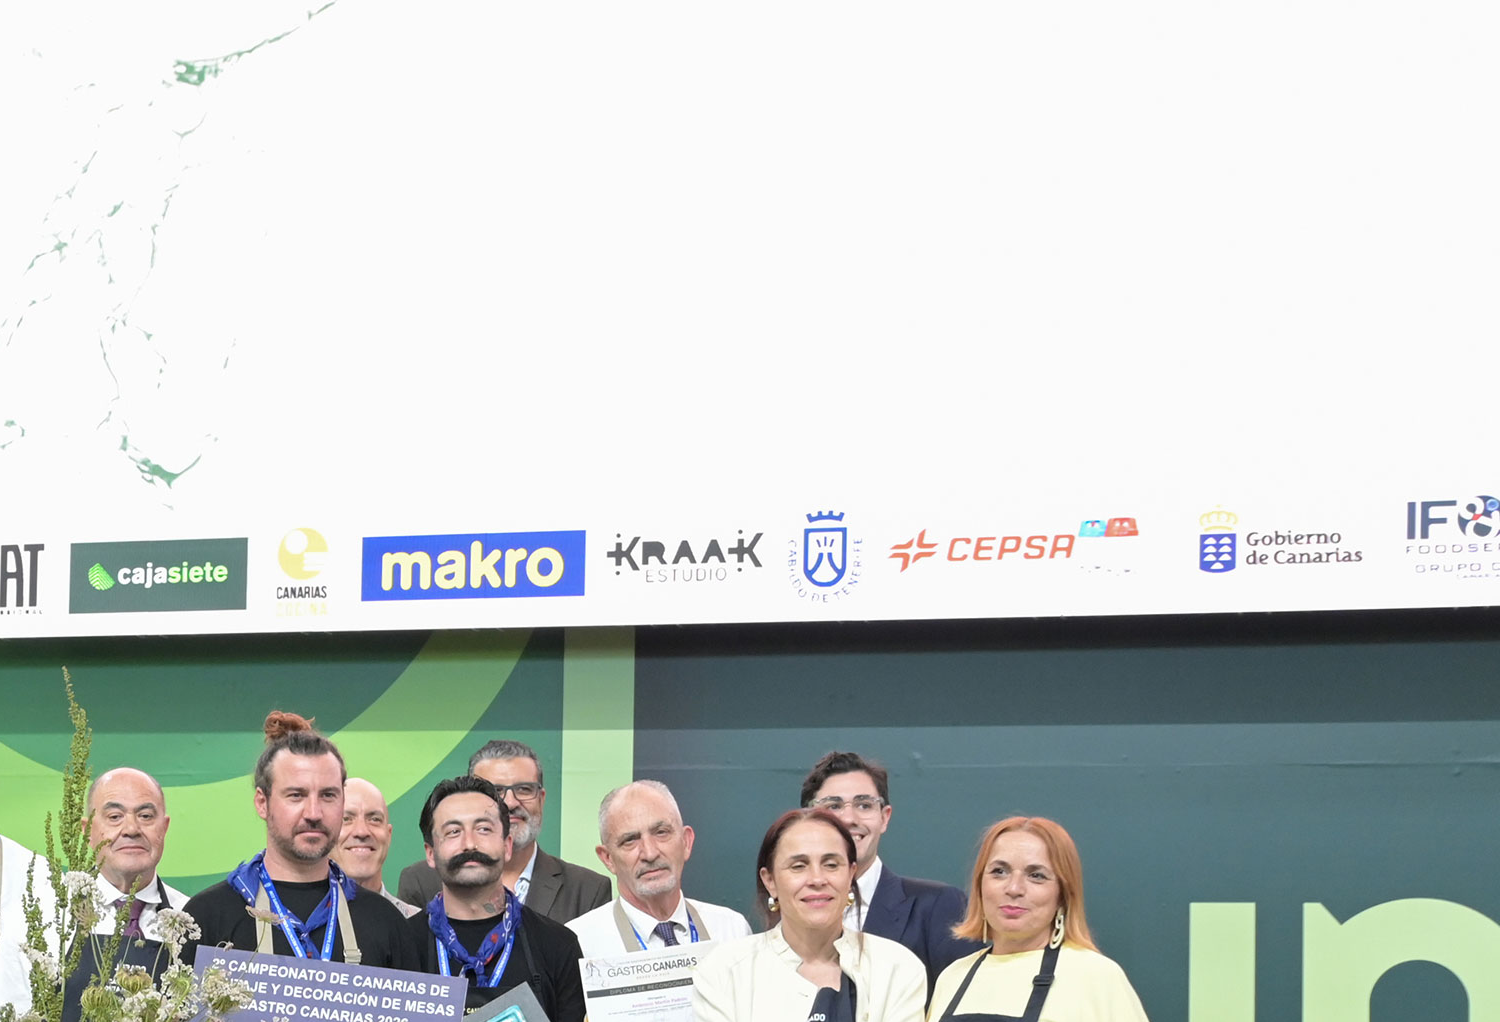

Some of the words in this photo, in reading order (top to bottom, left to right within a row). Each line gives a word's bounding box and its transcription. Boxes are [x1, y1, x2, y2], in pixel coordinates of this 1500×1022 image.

[946, 534, 1075, 561] CEPSA
[1246, 529, 1342, 547] Gobierno
[1246, 549, 1269, 566] de
[1272, 546, 1363, 565] Canarias
[1406, 543, 1500, 554] FOODSE
[117, 561, 228, 589] cajasiete
[381, 540, 565, 591] makro
[644, 566, 728, 584] ESTUDIO
[1415, 563, 1481, 573] GRUPO
[277, 585, 327, 599] CANARIAS
[229, 960, 326, 982] CAMPEONATO
[330, 973, 349, 986] DE
[353, 975, 426, 995] CANARIAS
[430, 984, 450, 998] DE
[610, 987, 636, 995] DIPLOMA
[647, 979, 694, 990] RECONOCIMIEN
[271, 984, 281, 995] Y
[283, 984, 378, 1009] DECORACIÓN
[382, 997, 401, 1010] DE
[405, 999, 455, 1017] MESAS
